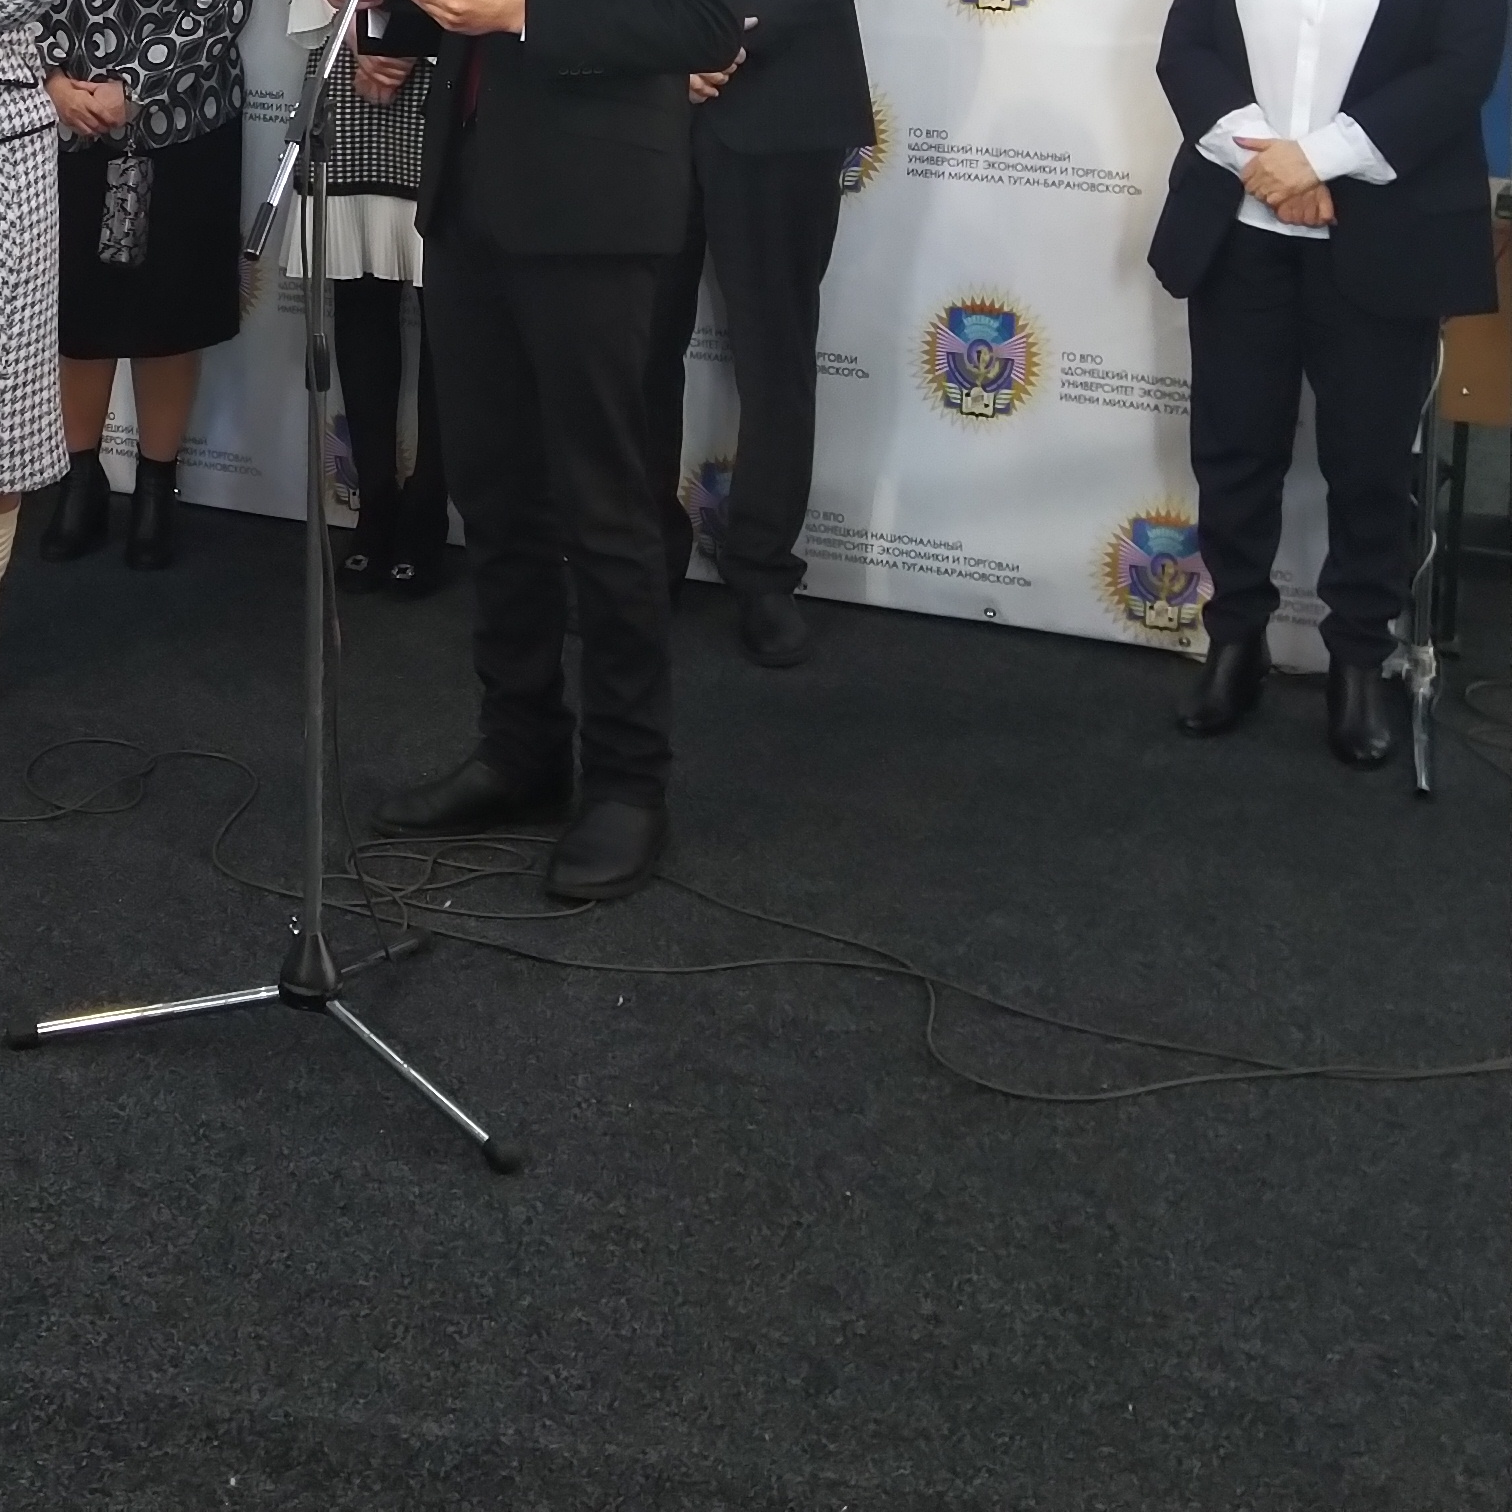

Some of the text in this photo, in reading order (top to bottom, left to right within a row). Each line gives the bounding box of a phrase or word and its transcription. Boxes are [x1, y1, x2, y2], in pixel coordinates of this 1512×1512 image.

[908, 127, 949, 140] ГО ВПО
[907, 141, 1071, 163] «ДОНЕЦКИЙ НАЦИОНАЛЬНЫЙ
[907, 154, 1130, 181] УНИВЕРСИТЕТ ЭКОНОМИКИ И ТОРГОВЛИ
[906, 167, 1143, 196] ИМЕНИ МИХАИЛА ТУГАН-БАРАНОВСКОГО»
[1061, 351, 1103, 365] ГО ВПО
[1060, 379, 1135, 396] УНИВЕРСИТЕТ
[1059, 392, 1100, 405] ИМЕНИ
[1102, 397, 1161, 414] МИХАИЛА
[822, 511, 845, 524] ВПО
[870, 531, 963, 551] НАЦИОНАЛЬНЫЙ
[876, 544, 950, 564] ЭКОНОМИКИ
[951, 554, 960, 565] И
[963, 556, 1020, 573] ТОРГОВЛИ
[844, 553, 899, 570] МИХАИЛА
[901, 561, 1032, 587] ТУГАН-БАРАНОВСКОГО»
